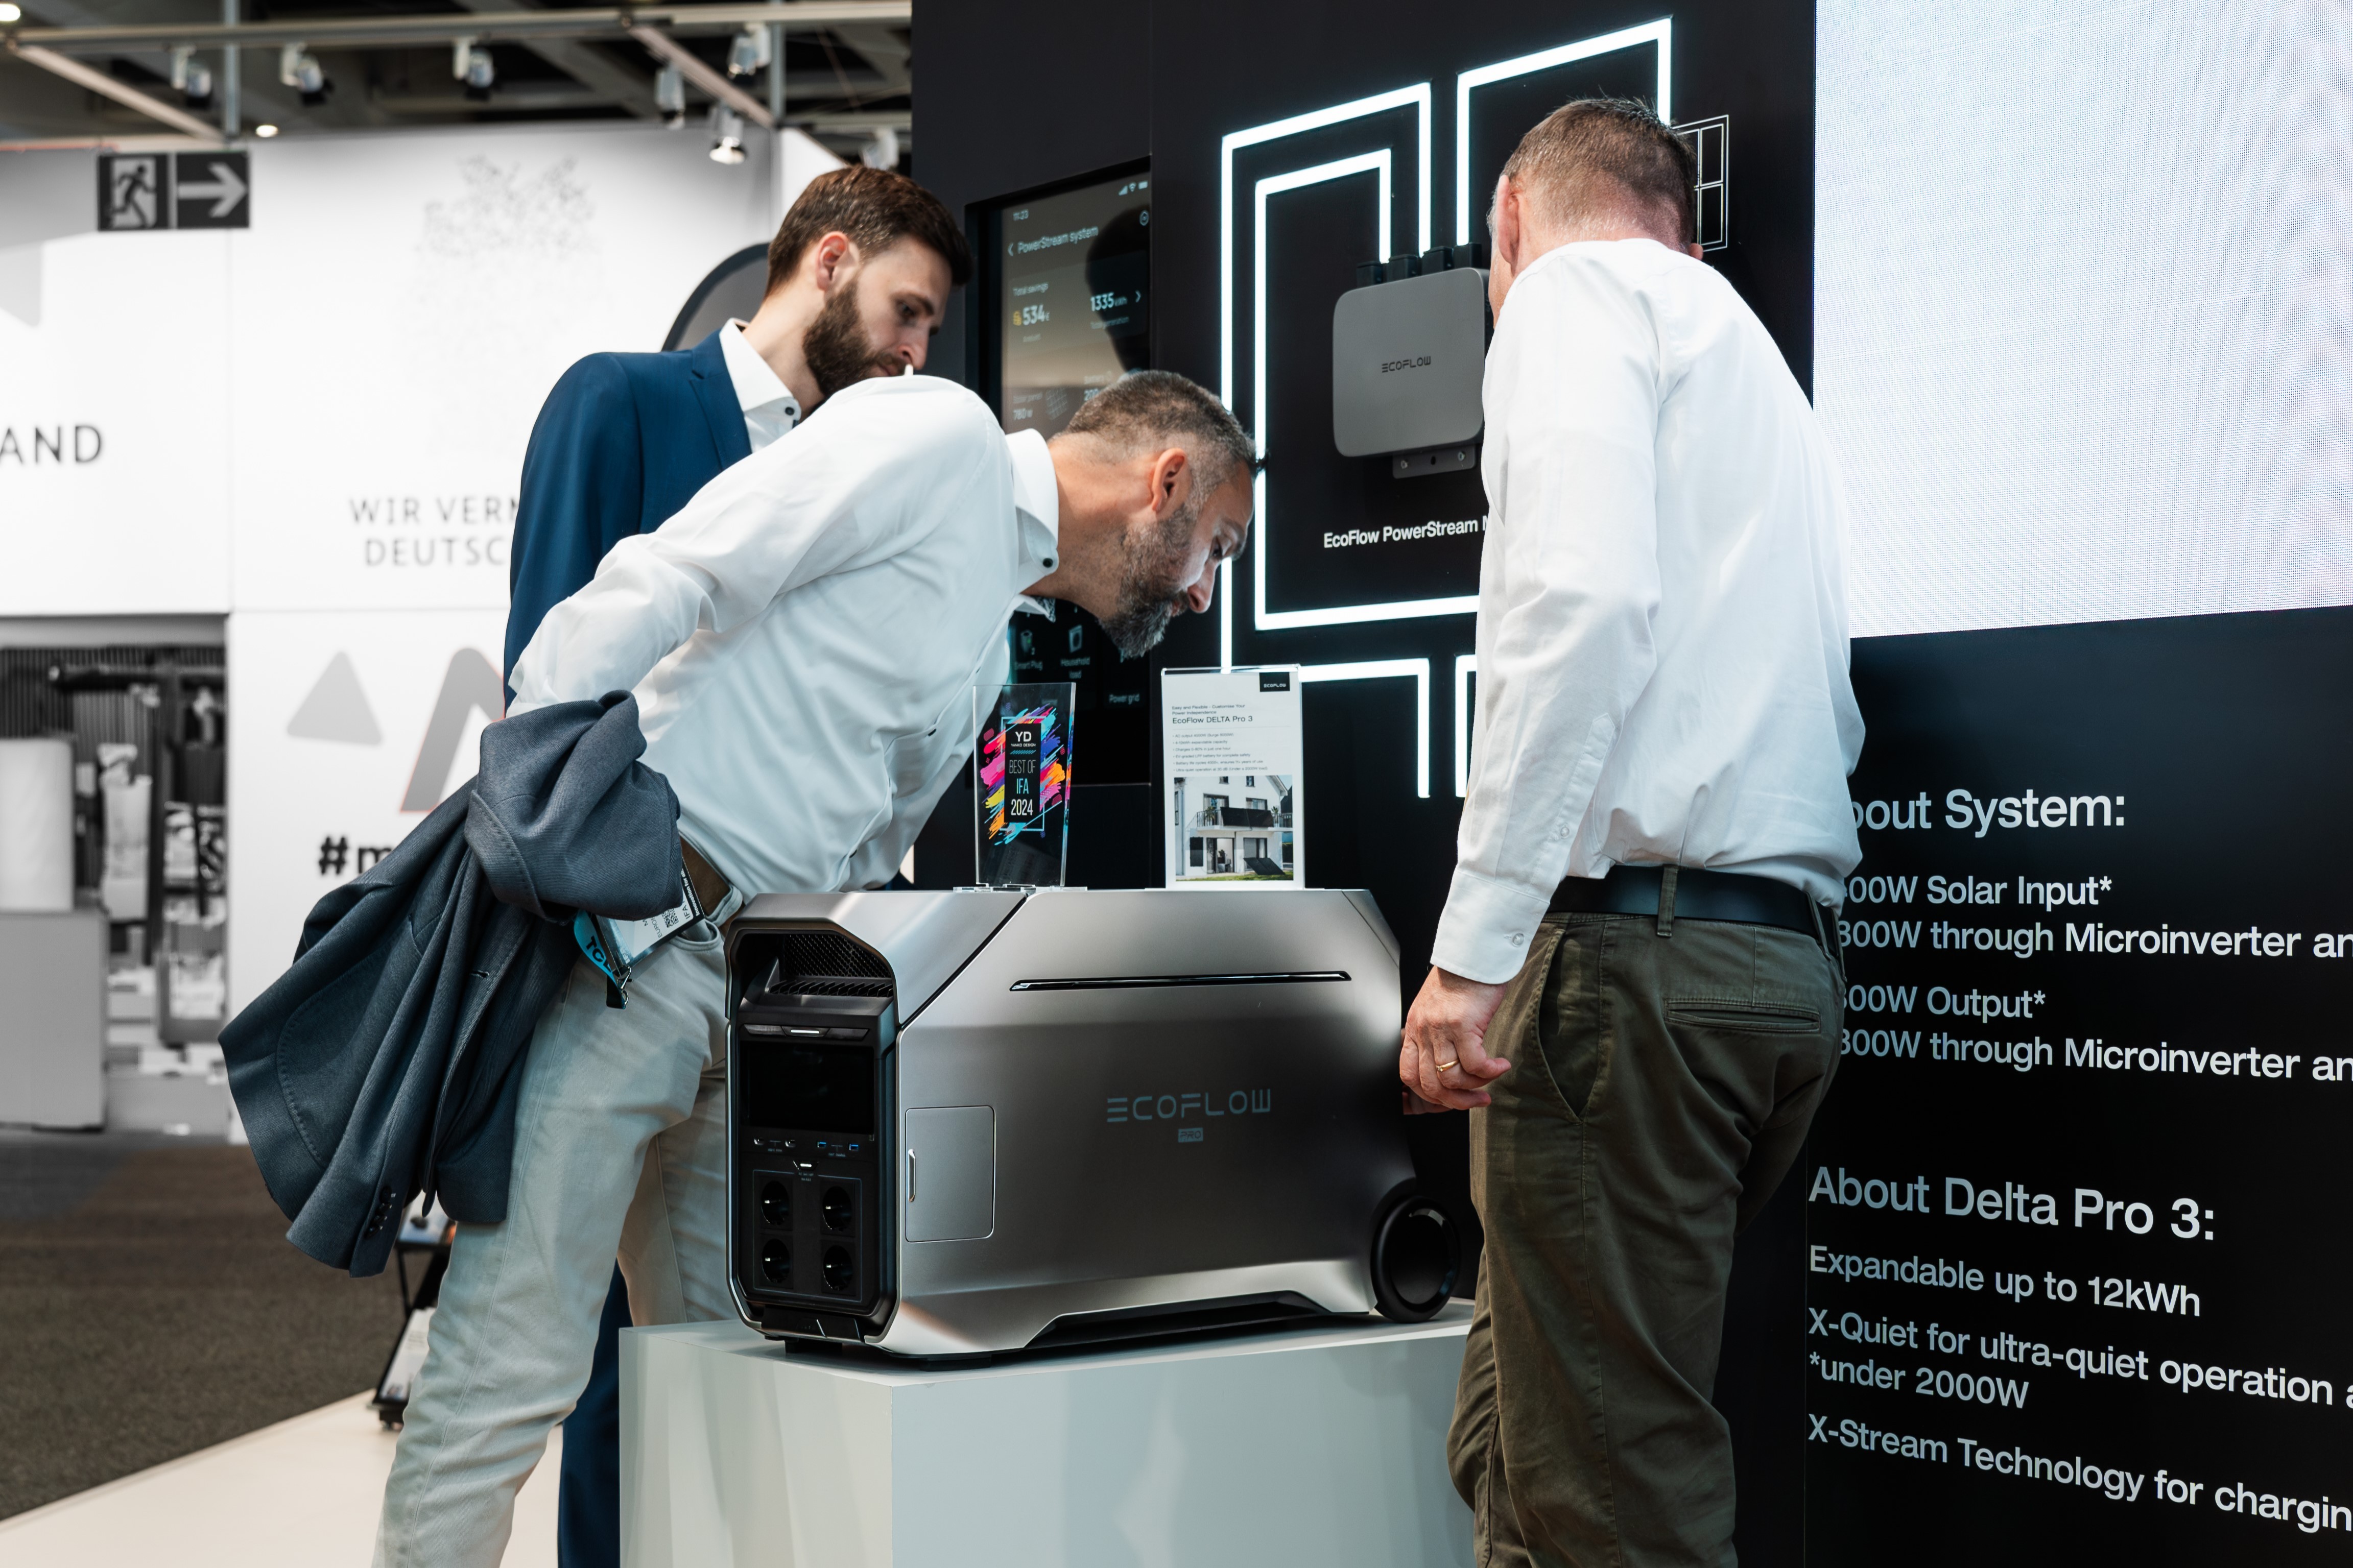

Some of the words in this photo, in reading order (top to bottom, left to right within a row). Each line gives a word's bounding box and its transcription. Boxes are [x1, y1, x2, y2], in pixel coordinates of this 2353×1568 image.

[1018, 233, 1068, 254] PowerStream
[1069, 226, 1099, 244] system
[1382, 356, 1431, 373] ECOFLOW
[349, 497, 421, 524] WIR
[1324, 529, 1380, 548] EcoFlow
[1383, 519, 1479, 542] PowerStream
[366, 538, 506, 566] DEUTSC
[1015, 731, 1032, 742] YD
[1009, 760, 1026, 774] BEST
[1027, 760, 1036, 774] OF
[1016, 778, 1029, 794] IFA
[1011, 799, 1033, 816] 2024
[1945, 788, 2125, 838] System:
[686, 886, 700, 916] Innovation
[1845, 876, 1918, 903] 00W
[1927, 875, 2008, 905] Solar
[682, 905, 691, 919] IFA
[651, 916, 662, 938] EURO
[1930, 921, 2054, 959] through
[2065, 922, 2301, 957] Microinverter
[1844, 984, 1918, 1012] 00W
[1929, 1032, 2053, 1072] through
[2065, 1038, 2301, 1078] Microinverter
[1107, 1089, 1271, 1122] ECOFLOW
[1179, 1129, 1202, 1141] PRO
[1809, 1166, 1930, 1213] About
[1945, 1177, 2059, 1226] Delta
[2075, 1188, 2154, 1235] Pro
[2171, 1197, 2214, 1241] 3:
[1810, 1244, 1984, 1291] Expandable
[1995, 1272, 2034, 1303] up
[2043, 1271, 2077, 1302] to
[2088, 1276, 2200, 1317] 12kWh
[1808, 1307, 1918, 1349] X-Quiet
[1927, 1322, 1970, 1355] for
[1980, 1332, 2149, 1381] ultra-quiet
[2159, 1360, 2333, 1406] operation
[1915, 1367, 2029, 1409] 2000W
[1808, 1413, 1947, 1463] X-Stream
[1957, 1437, 2145, 1502] Technology
[2154, 1469, 2204, 1505] for
[2215, 1482, 2352, 1533] chargin
